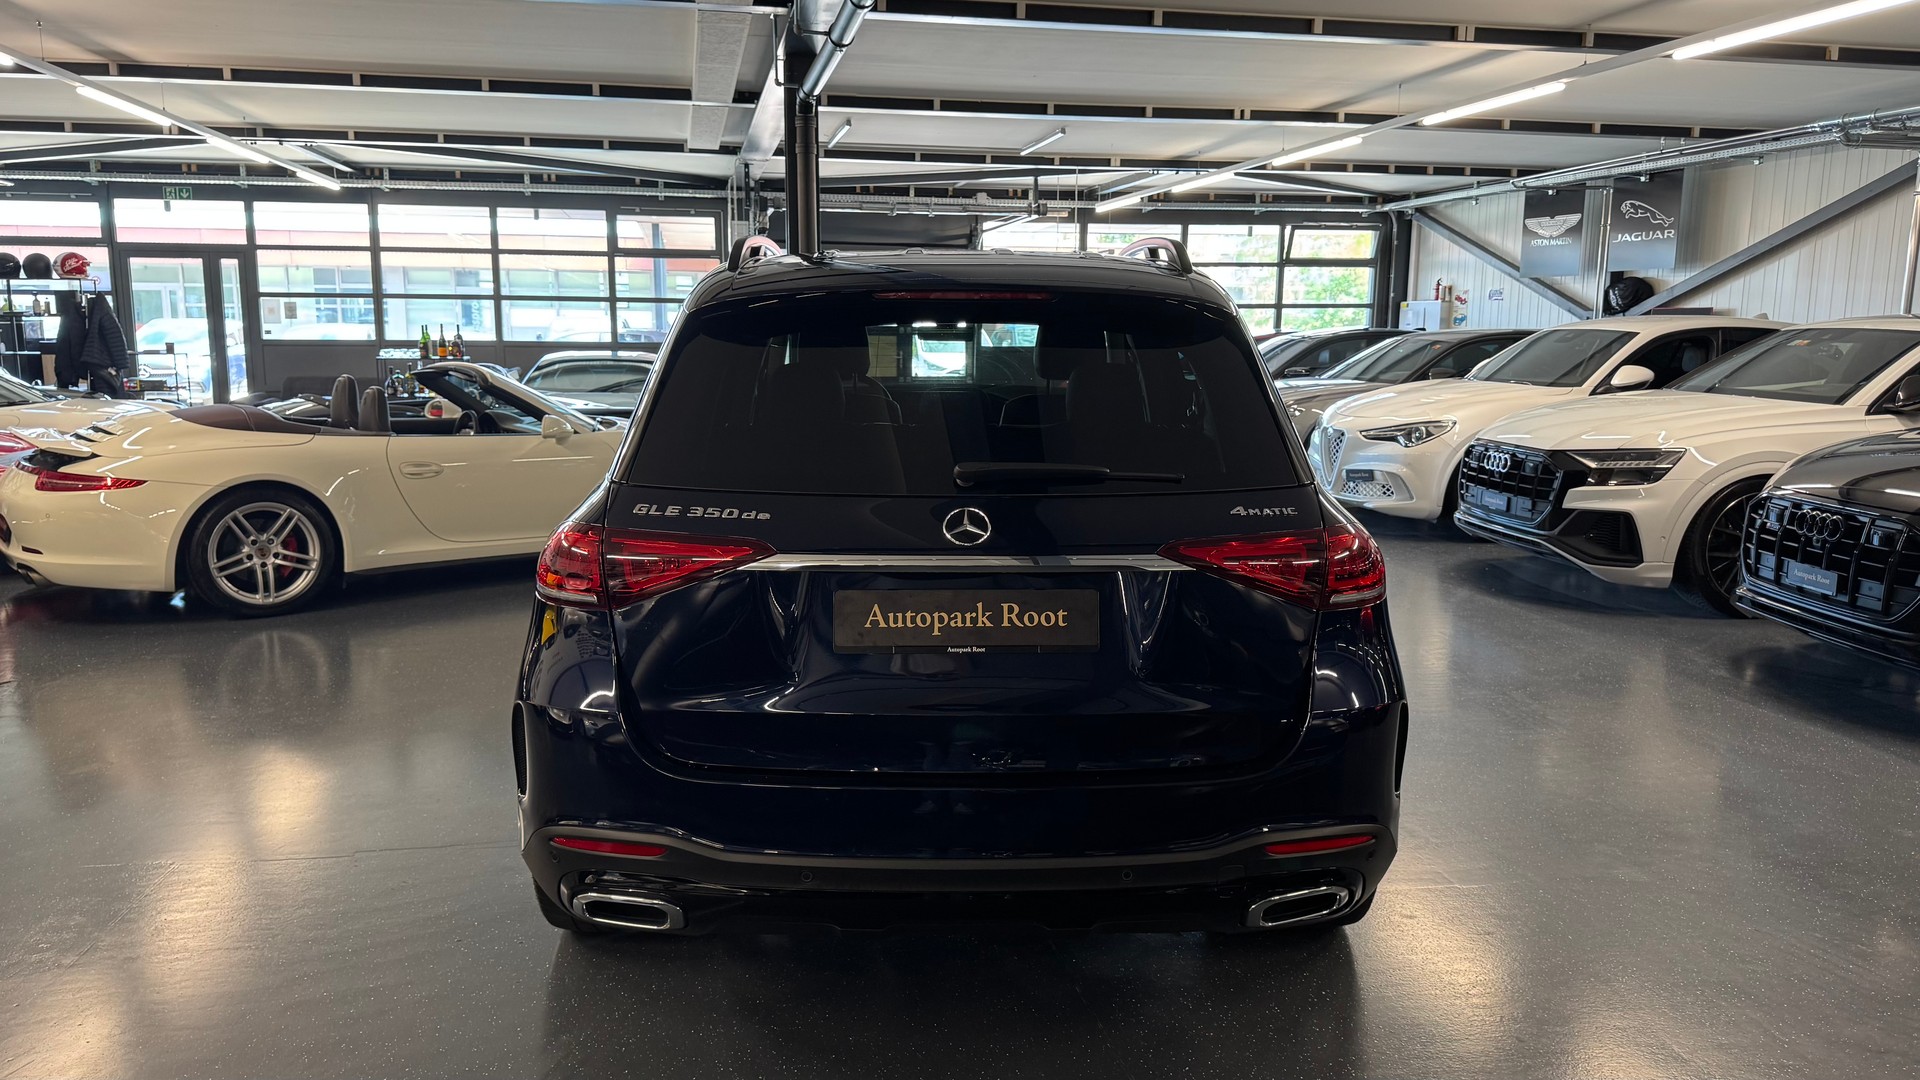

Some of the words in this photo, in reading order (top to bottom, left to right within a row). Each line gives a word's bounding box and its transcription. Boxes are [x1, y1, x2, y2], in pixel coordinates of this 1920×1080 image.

[1530, 239, 1549, 247] ASTON
[1550, 237, 1573, 246] MARTIN
[1612, 229, 1675, 243] JAGUAR
[633, 503, 682, 516] GLE
[1230, 506, 1298, 516] 4MATIC
[1793, 568, 1817, 581] Autopark
[1817, 574, 1830, 585] Root
[864, 601, 994, 635] Autopark
[1000, 602, 1068, 628] Root
